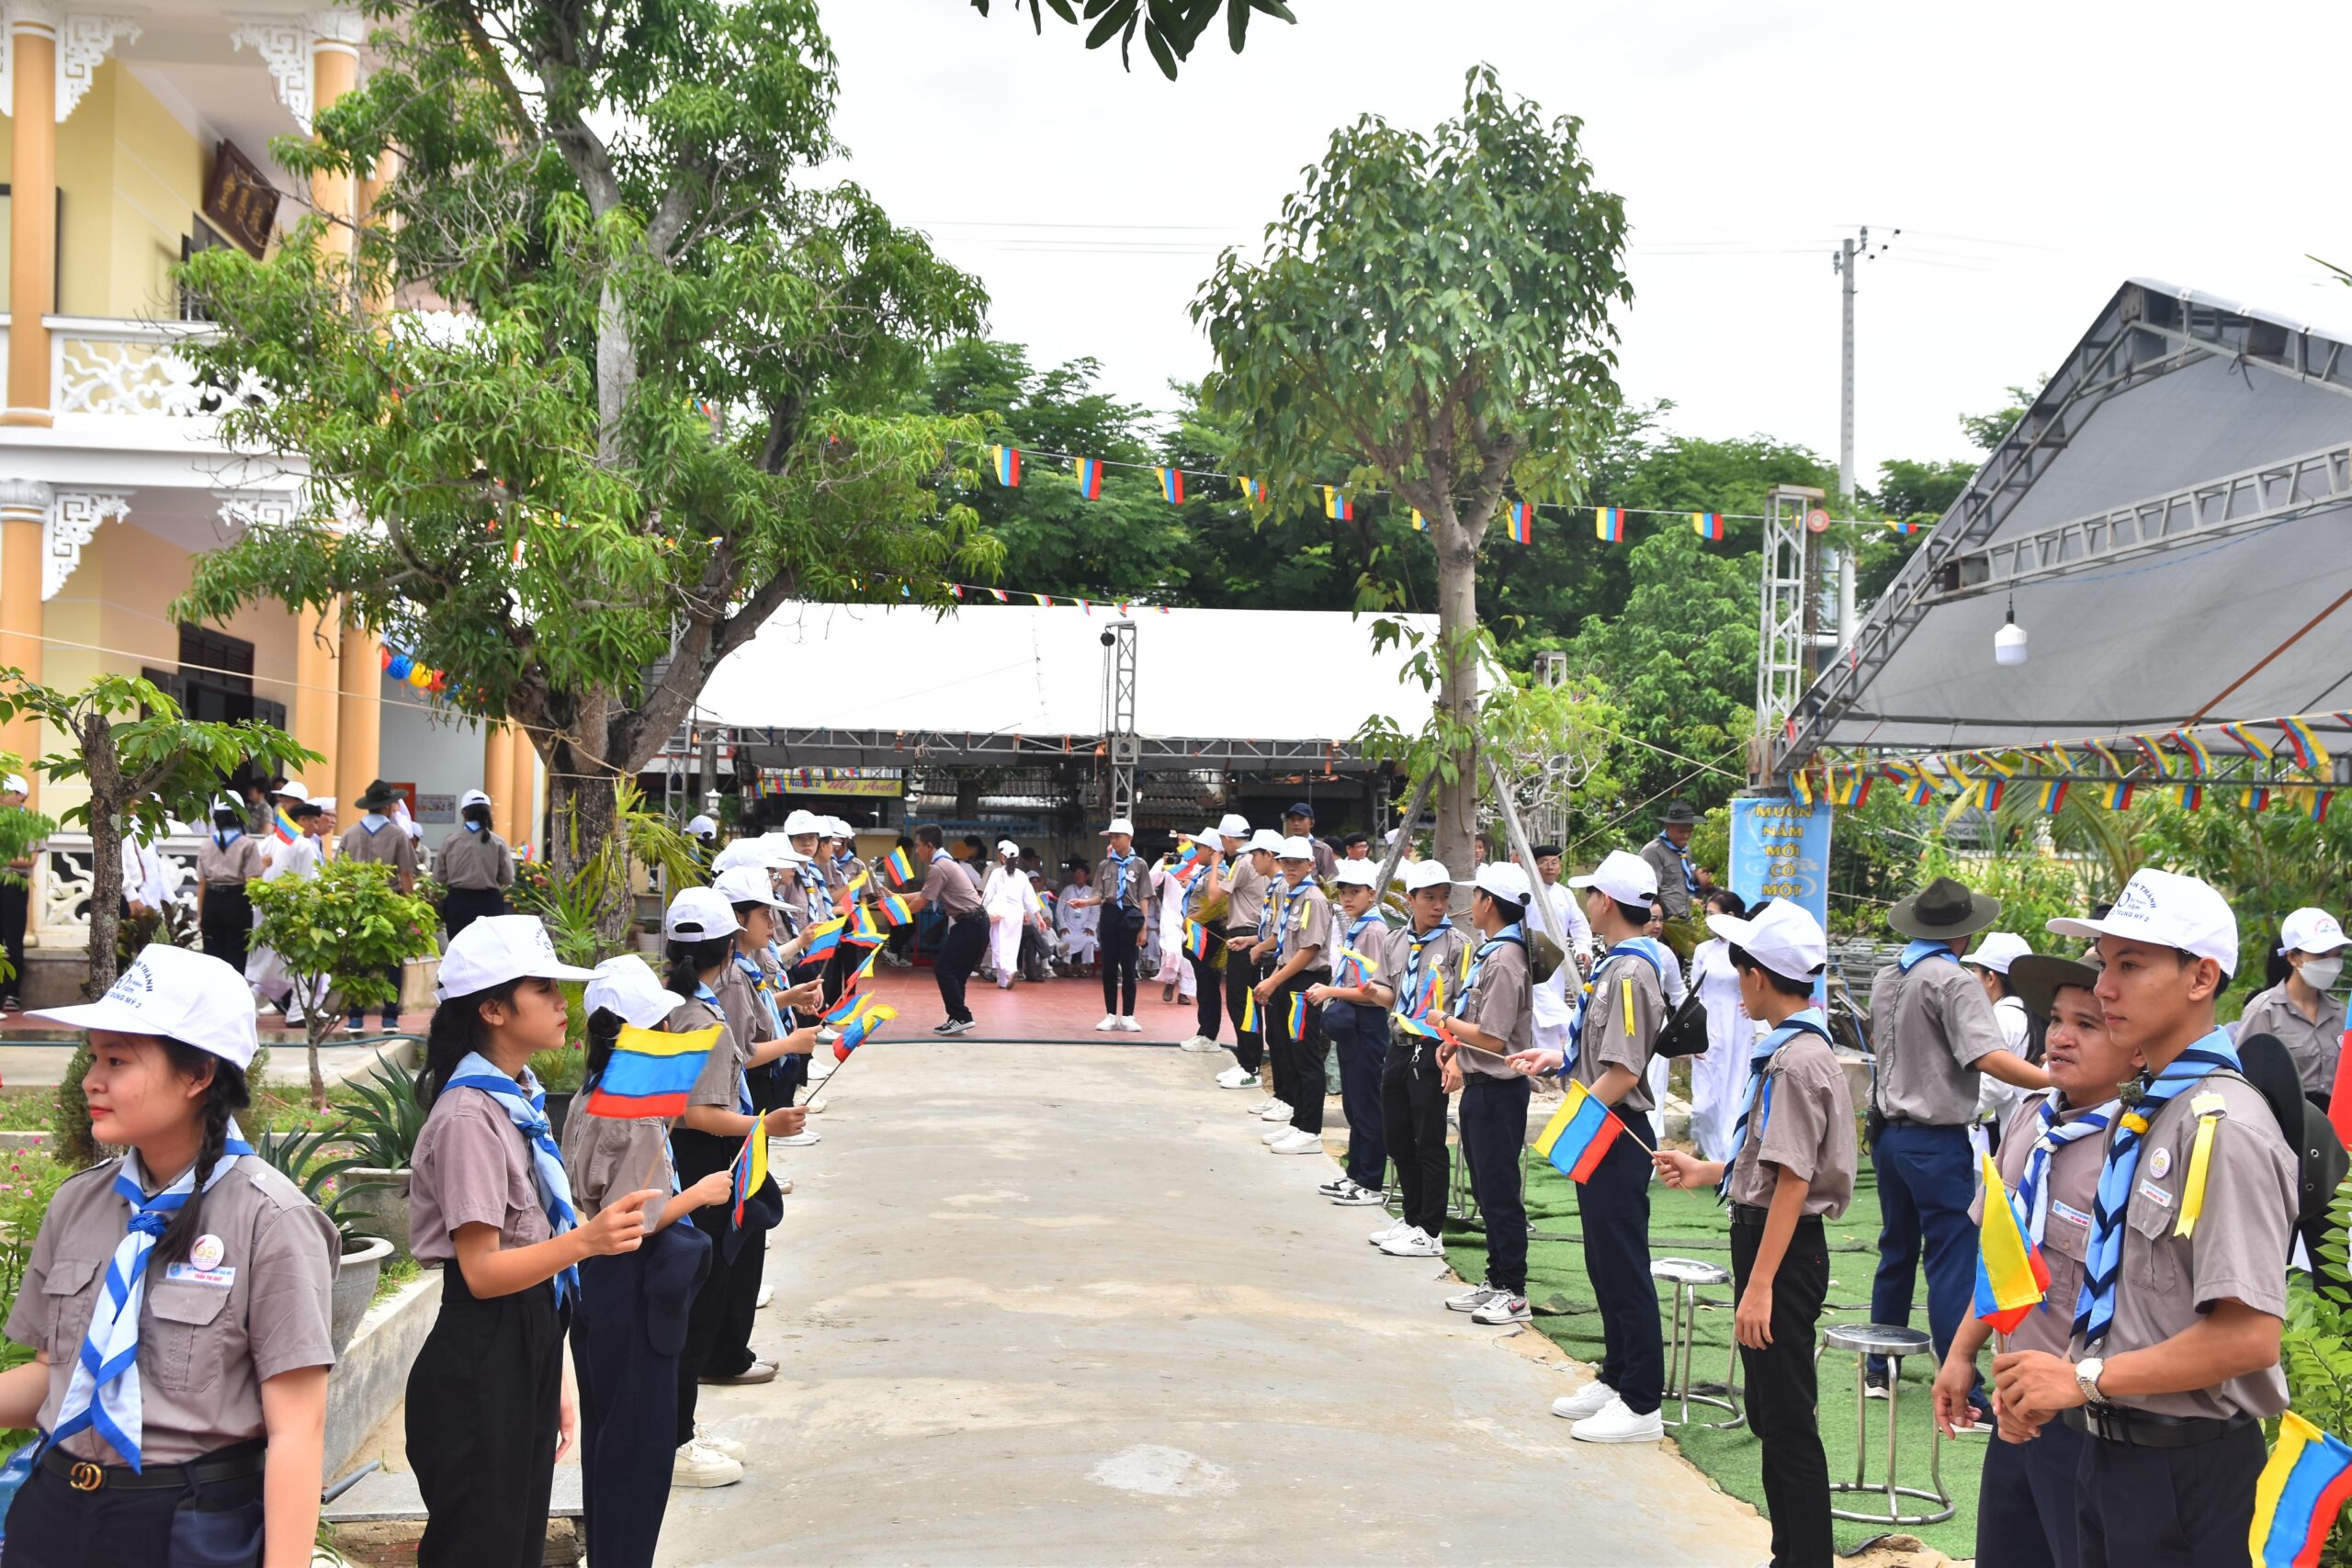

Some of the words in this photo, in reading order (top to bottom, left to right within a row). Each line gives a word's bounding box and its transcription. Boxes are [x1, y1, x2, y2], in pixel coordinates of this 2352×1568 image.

[1762, 823, 1804, 838] NĂM
[1765, 842, 1801, 857] MỚI
[1770, 862, 1796, 876] CÓ
[1762, 882, 1803, 899] MỘT
